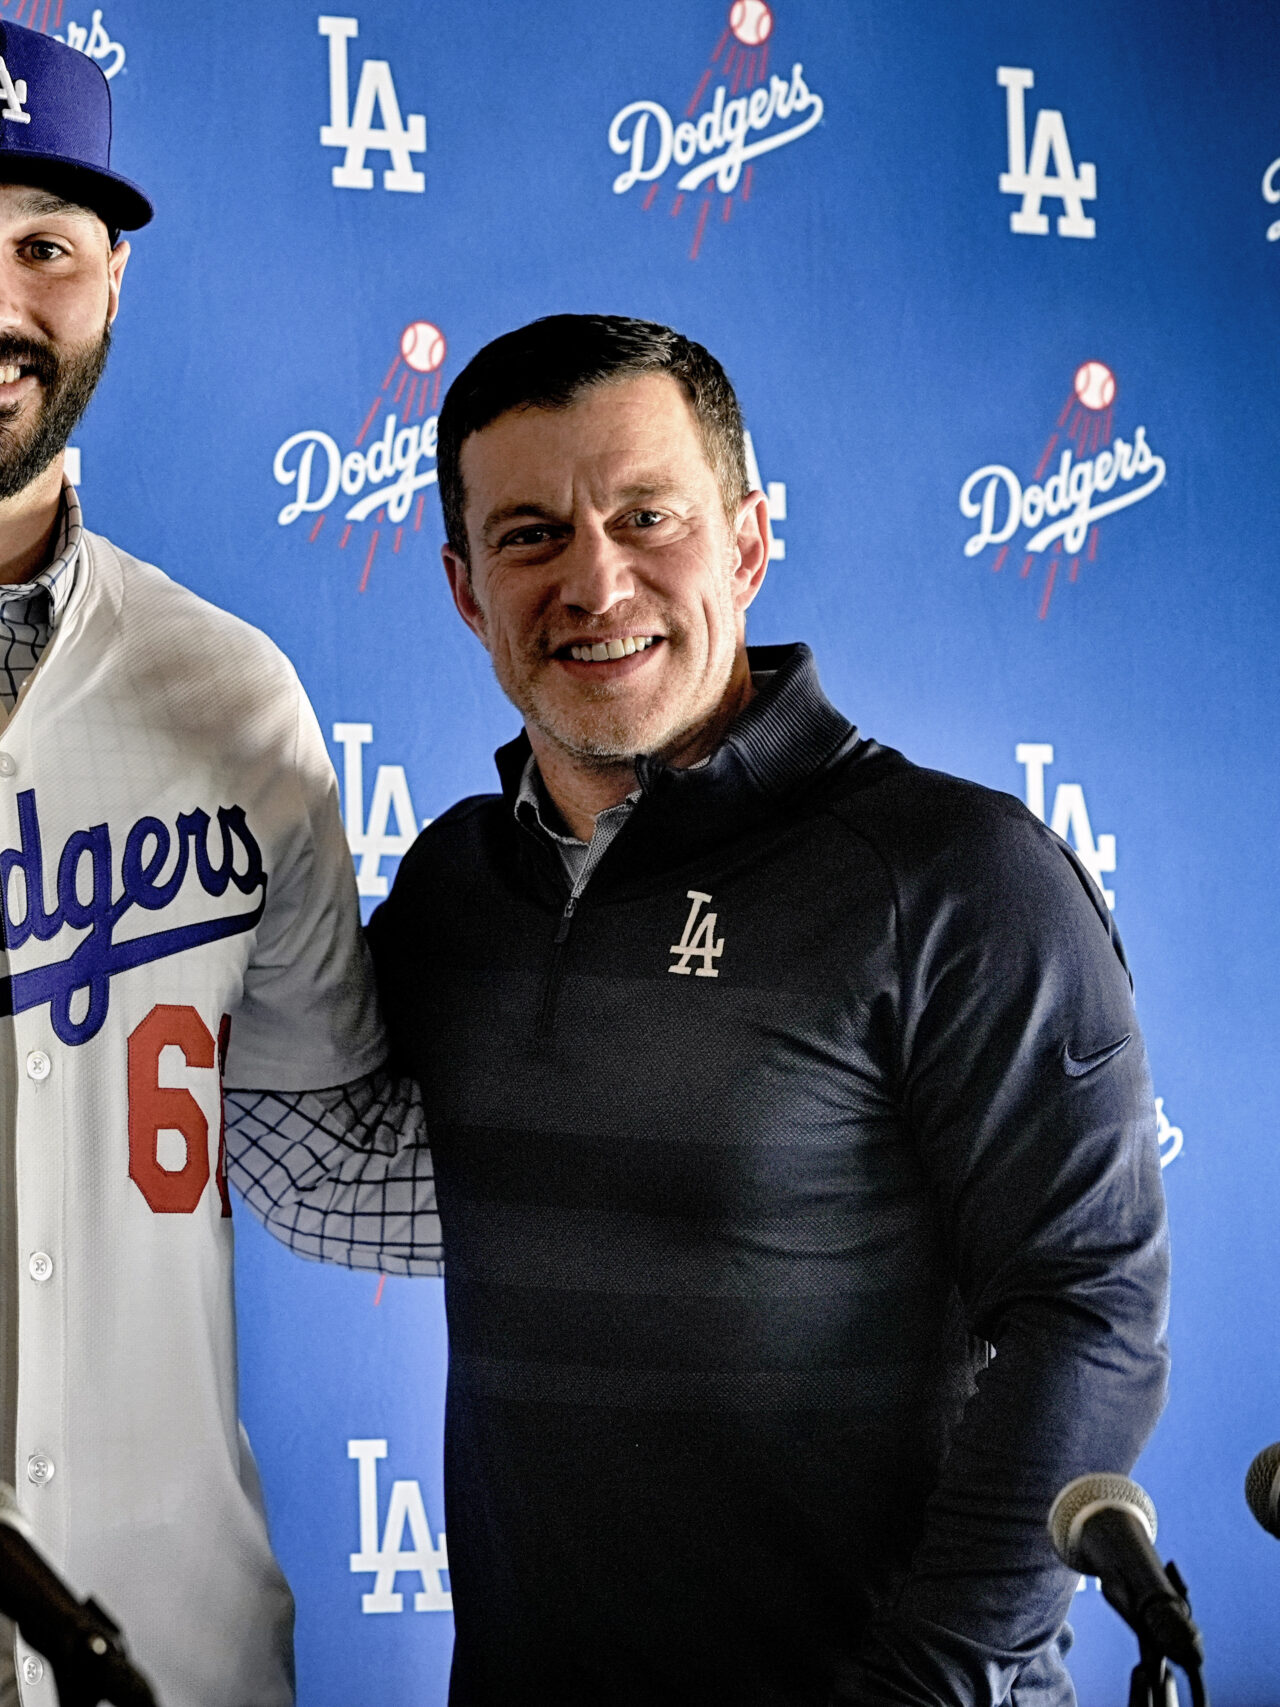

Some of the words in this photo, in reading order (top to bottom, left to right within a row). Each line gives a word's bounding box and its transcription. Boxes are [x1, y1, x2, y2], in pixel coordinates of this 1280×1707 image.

[318, 15, 427, 193] LA
[608, 63, 824, 195] Dodgers
[996, 66, 1097, 239] LA
[273, 414, 439, 526] Dodge
[959, 426, 1167, 557] Dodgers
[332, 723, 434, 898] LA
[668, 890, 725, 978] LA
[127, 1003, 232, 1217] 6
[347, 1439, 455, 1614] LA
